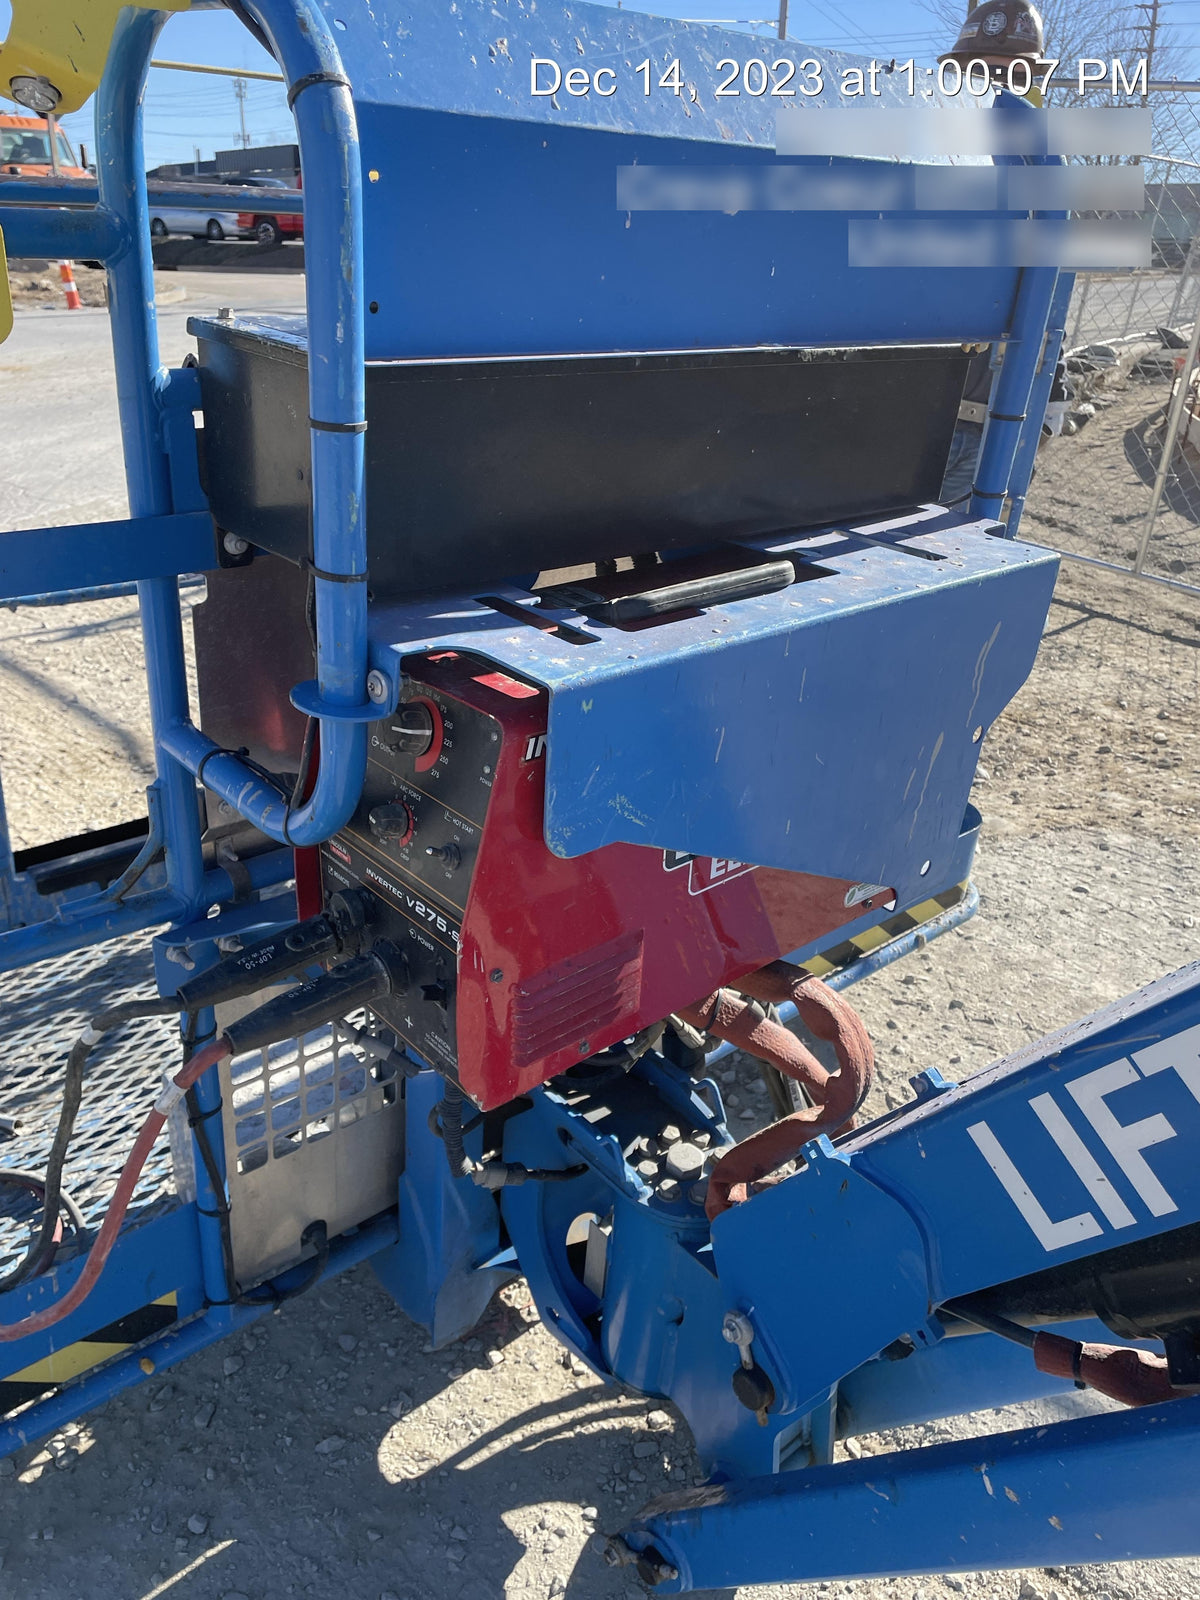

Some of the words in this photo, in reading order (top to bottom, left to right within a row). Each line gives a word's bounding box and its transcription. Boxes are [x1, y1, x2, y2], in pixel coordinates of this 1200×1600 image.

[444, 719, 453, 730] 200
[443, 738, 453, 748] 225
[439, 754, 449, 765] 250
[431, 768, 440, 779] 275
[366, 867, 403, 899] INVERTEC
[417, 935, 434, 951] POWER
